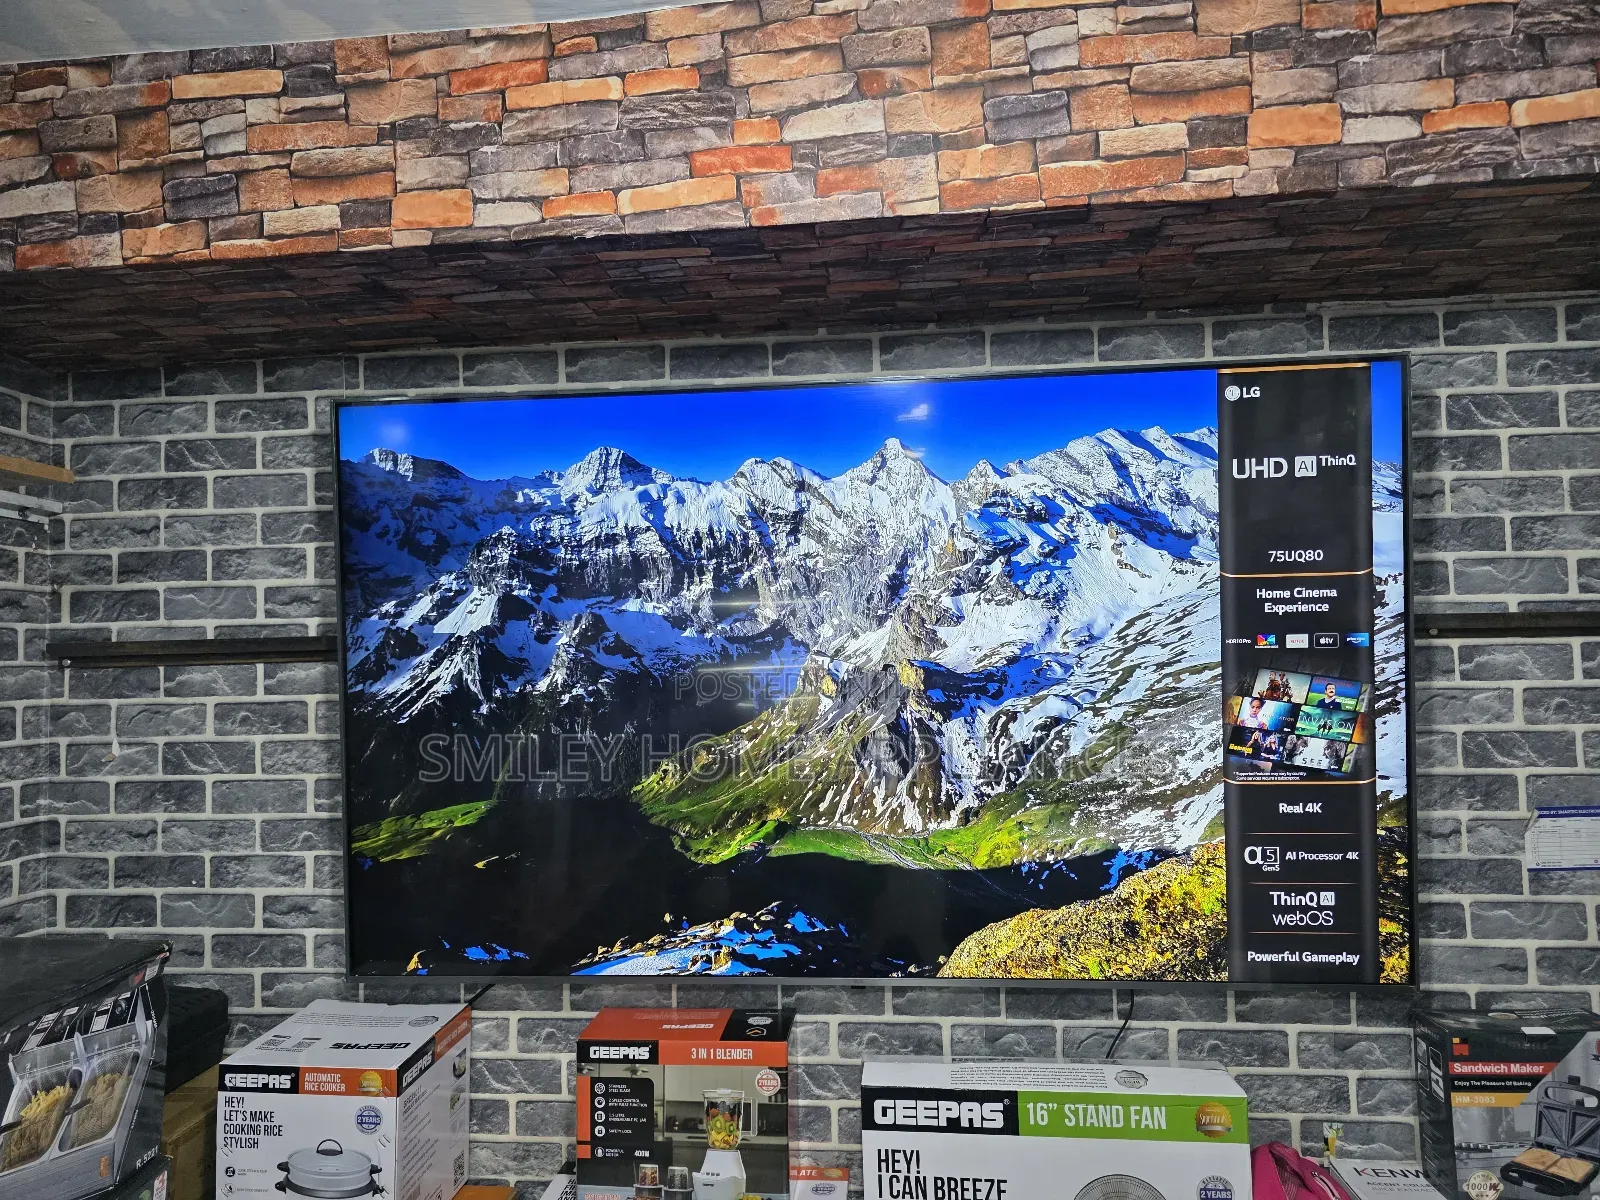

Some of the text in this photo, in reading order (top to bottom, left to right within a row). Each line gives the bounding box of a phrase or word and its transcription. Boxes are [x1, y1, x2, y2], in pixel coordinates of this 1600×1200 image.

[1242, 386, 1260, 398] LG
[1232, 454, 1356, 478] UHD AI ThinQ
[1268, 550, 1324, 562] 75UQ80
[1256, 588, 1337, 598] Home Cinema
[1264, 602, 1330, 616] Experience
[1298, 714, 1354, 730] INVASION
[1279, 803, 1322, 814] Real 4K
[1286, 851, 1359, 861] AI Processor 4K
[1270, 892, 1334, 908] ThinQ AI
[1272, 911, 1334, 926] webOS
[1248, 951, 1360, 965] Powerful Gameplay
[590, 1046, 650, 1059] GEEPAS
[692, 1048, 753, 1060] 3 IN 1 BLENDER
[1454, 1063, 1544, 1073] Sandwich Maker
[224, 1073, 292, 1089] GEEPAS
[305, 1073, 341, 1082] AUTOMATIC
[305, 1082, 345, 1092] RICE COOKER
[225, 1096, 244, 1108] HEY!
[224, 1110, 274, 1122] LET'S MAKE
[873, 1099, 1004, 1128] GEEPAS
[1064, 1104, 1124, 1128] STAND
[1129, 1106, 1167, 1129] FAN
[362, 1116, 380, 1124] YEARS
[224, 1123, 283, 1136] COOKING RICE
[224, 1137, 259, 1149] STYLISH
[877, 1149, 921, 1174] HEY!
[878, 1174, 883, 1198] I
[889, 1175, 927, 1200] CAN
[1465, 1183, 1500, 1192] 1000W
[1206, 1191, 1231, 1199] YEARS
